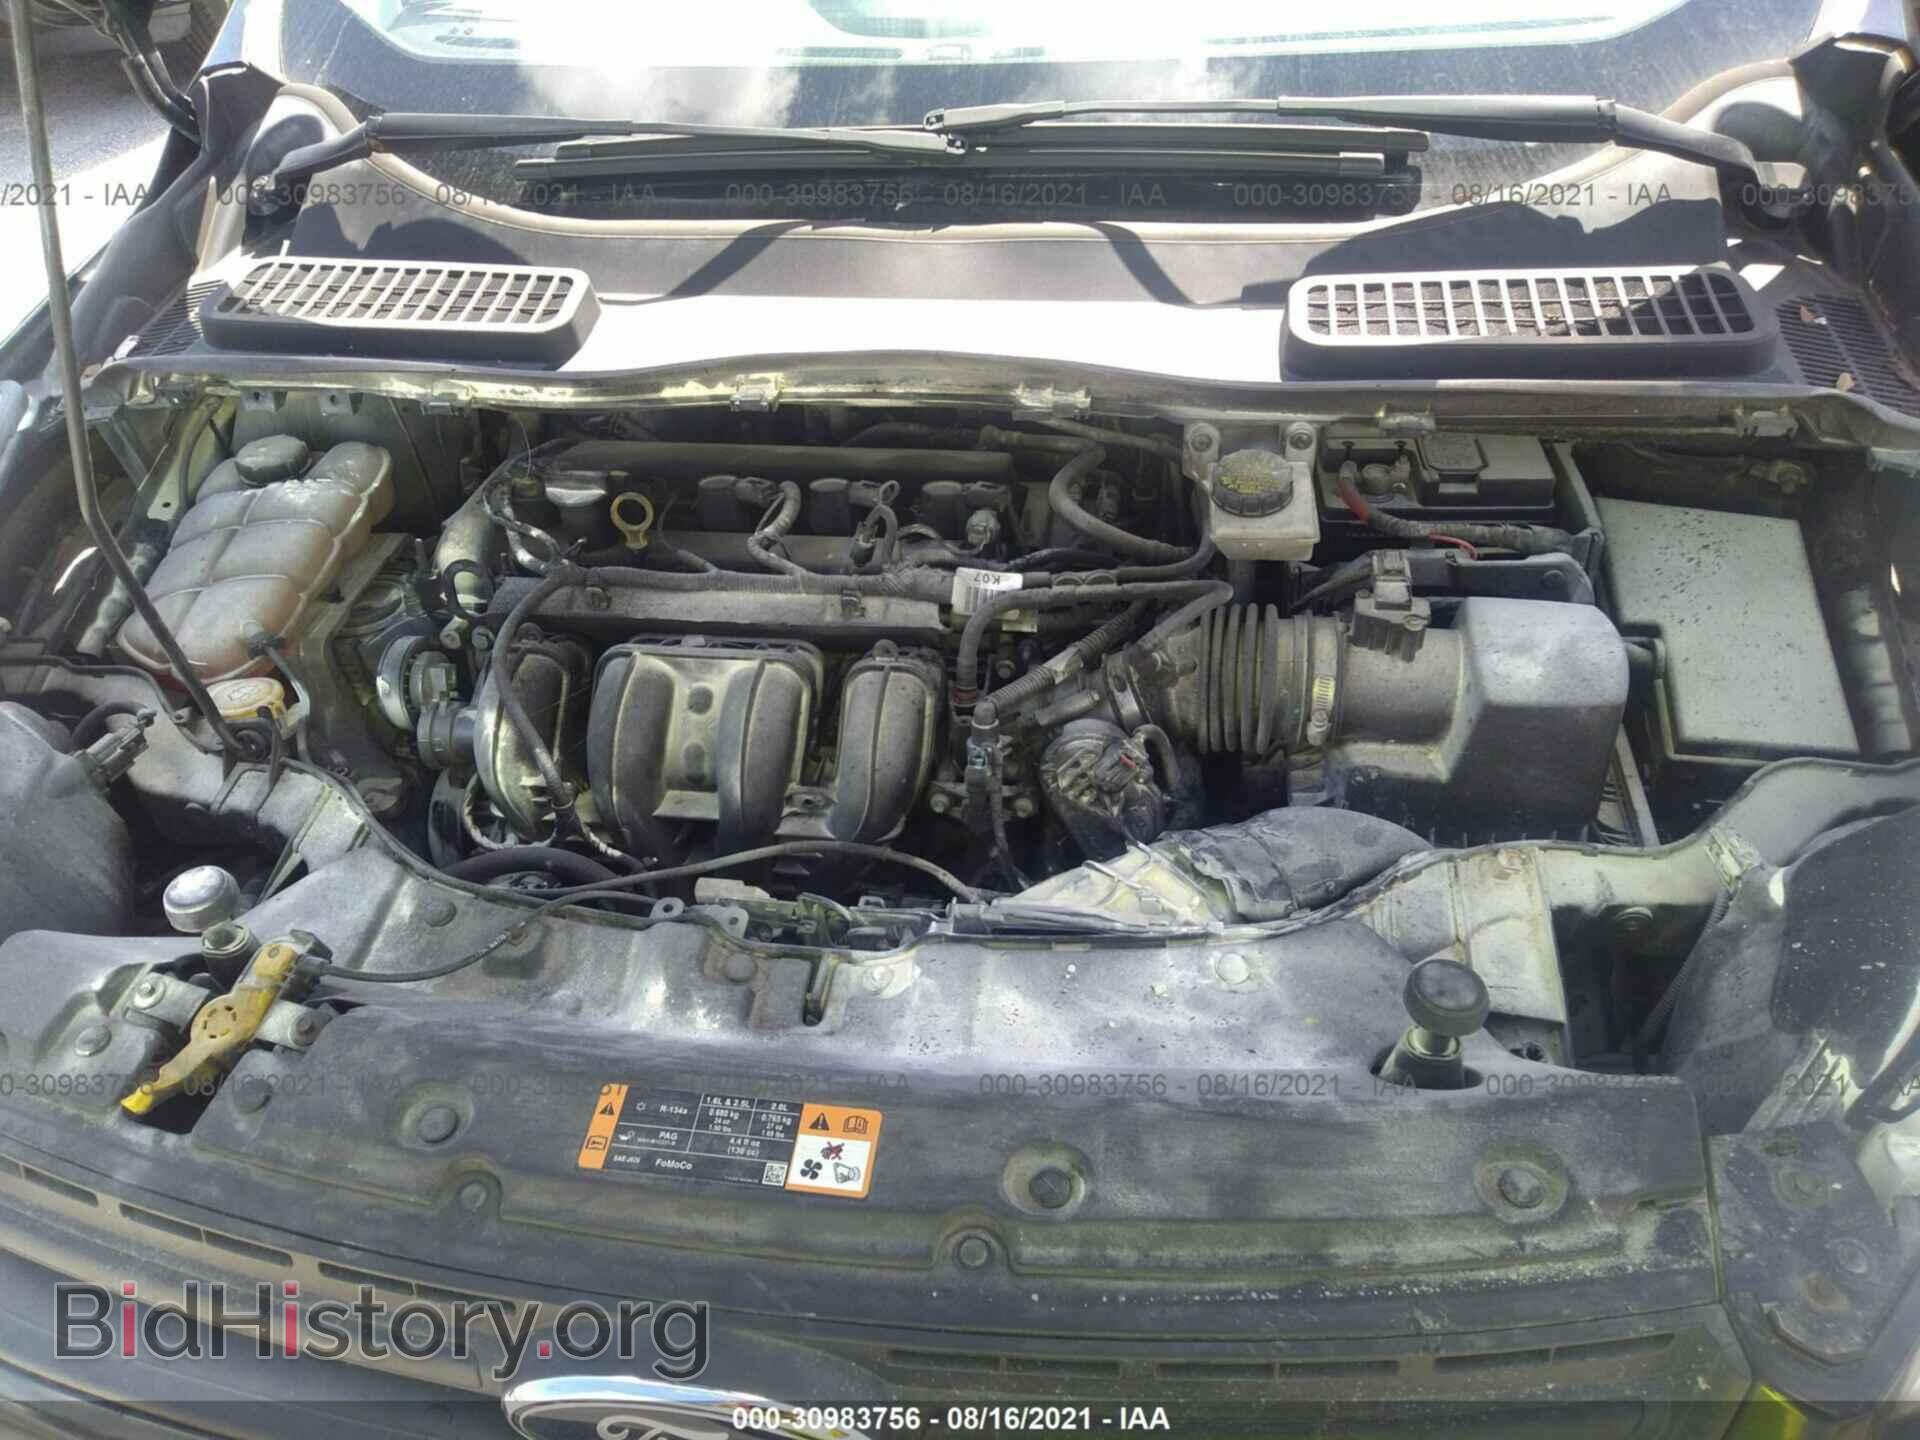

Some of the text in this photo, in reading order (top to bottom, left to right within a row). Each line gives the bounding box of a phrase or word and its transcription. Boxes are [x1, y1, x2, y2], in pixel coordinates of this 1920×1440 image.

[660, 1104, 688, 1115] R-134a
[659, 1131, 678, 1140] PAG
[655, 1158, 693, 1170] FoMoCo
